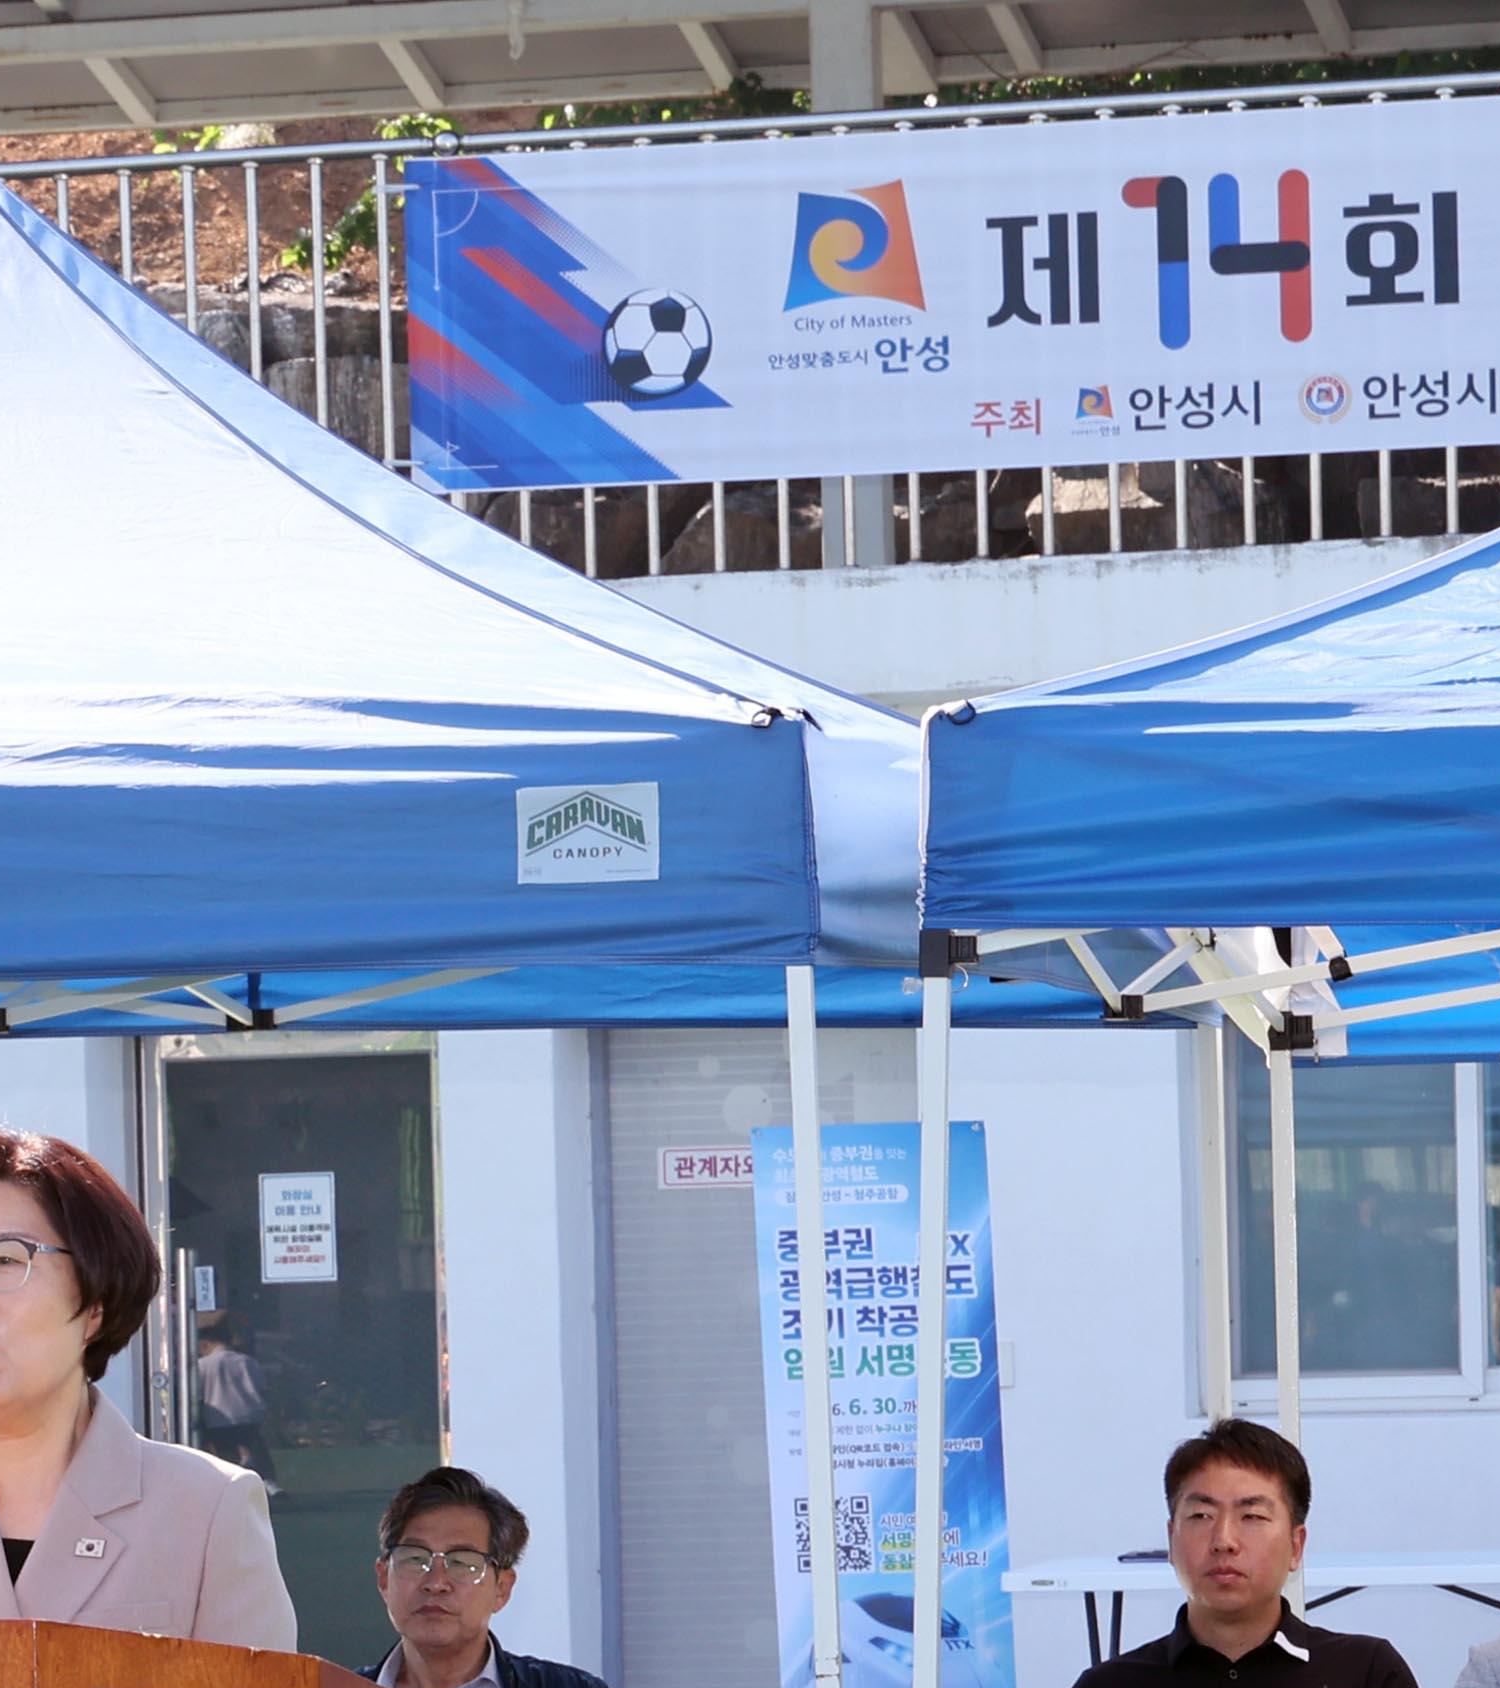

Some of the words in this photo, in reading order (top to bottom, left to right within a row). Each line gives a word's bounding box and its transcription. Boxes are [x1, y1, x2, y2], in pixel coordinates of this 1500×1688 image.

[794, 315, 825, 333] City
[830, 315, 846, 329] of
[851, 313, 913, 329] Masters
[768, 349, 869, 370] 안성맞춤도시
[874, 335, 951, 374] 안성
[970, 398, 1042, 438] 주최
[1128, 380, 1262, 431] 안성시
[526, 796, 647, 850] CARAVAN
[553, 846, 624, 860] CANOPY
[856, 1342, 979, 1377] 서명동
